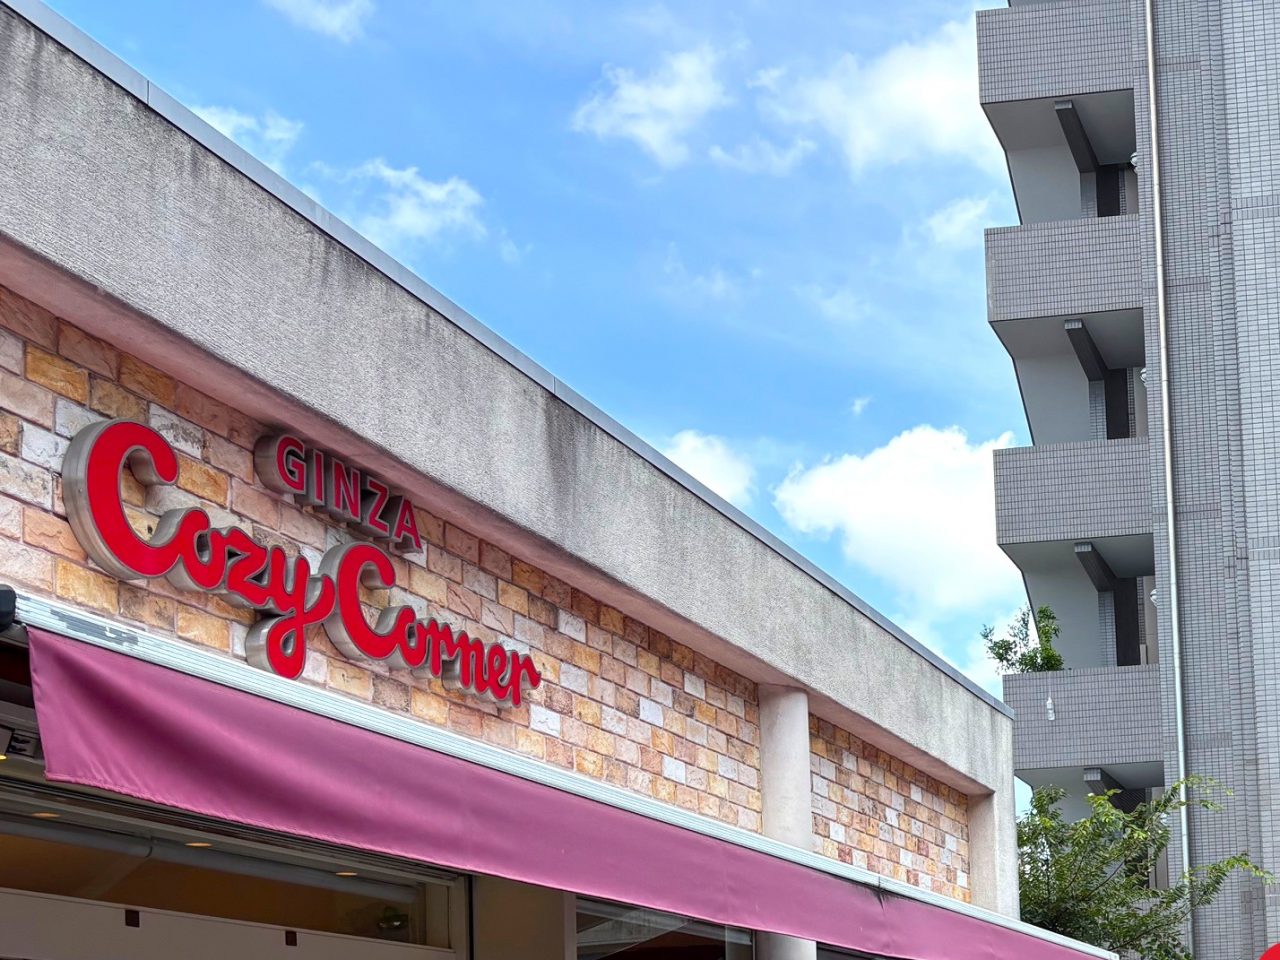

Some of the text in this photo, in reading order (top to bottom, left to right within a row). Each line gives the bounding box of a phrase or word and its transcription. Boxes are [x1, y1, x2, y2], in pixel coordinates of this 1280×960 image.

[75, 420, 541, 706] Cozy Corner
[268, 434, 424, 553] GINZA
